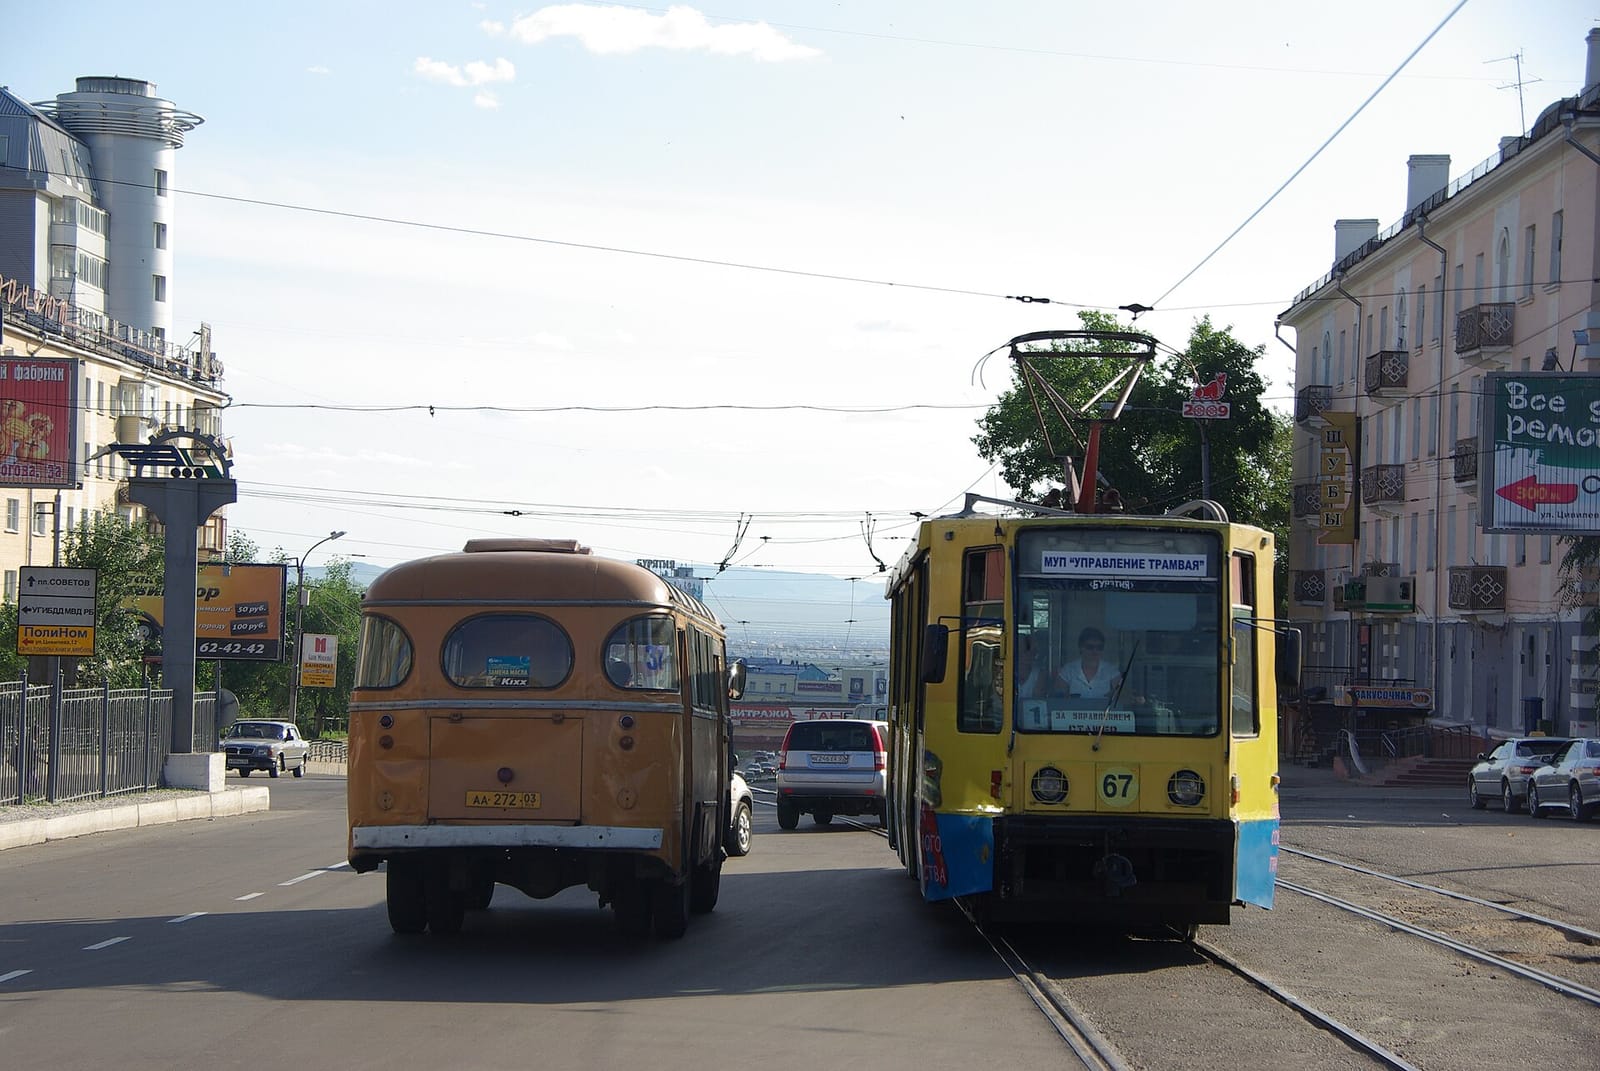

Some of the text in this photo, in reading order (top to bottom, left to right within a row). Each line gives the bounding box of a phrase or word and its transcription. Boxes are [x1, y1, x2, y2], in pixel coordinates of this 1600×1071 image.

[14, 364, 64, 381] фабрики
[1505, 381, 1566, 413] Все
[1184, 404, 1228, 417] 2009
[1, 464, 40, 478] огова,
[1325, 430, 1342, 526] ШУБЫ
[1516, 486, 1547, 500] 300
[1044, 556, 1066, 568] МУП
[84, 608, 94, 616] РБ
[238, 604, 267, 614] 50 руб.
[24, 627, 88, 638] ПолиНом
[232, 621, 266, 632] 100 руб.
[200, 642, 265, 654] 62-42-42
[501, 677, 528, 686] Kixx
[1355, 690, 1412, 701] ЗАКУСОЧНАЯ
[1103, 774, 1133, 798] 67
[494, 793, 516, 806] 272
[524, 793, 536, 803] 03
